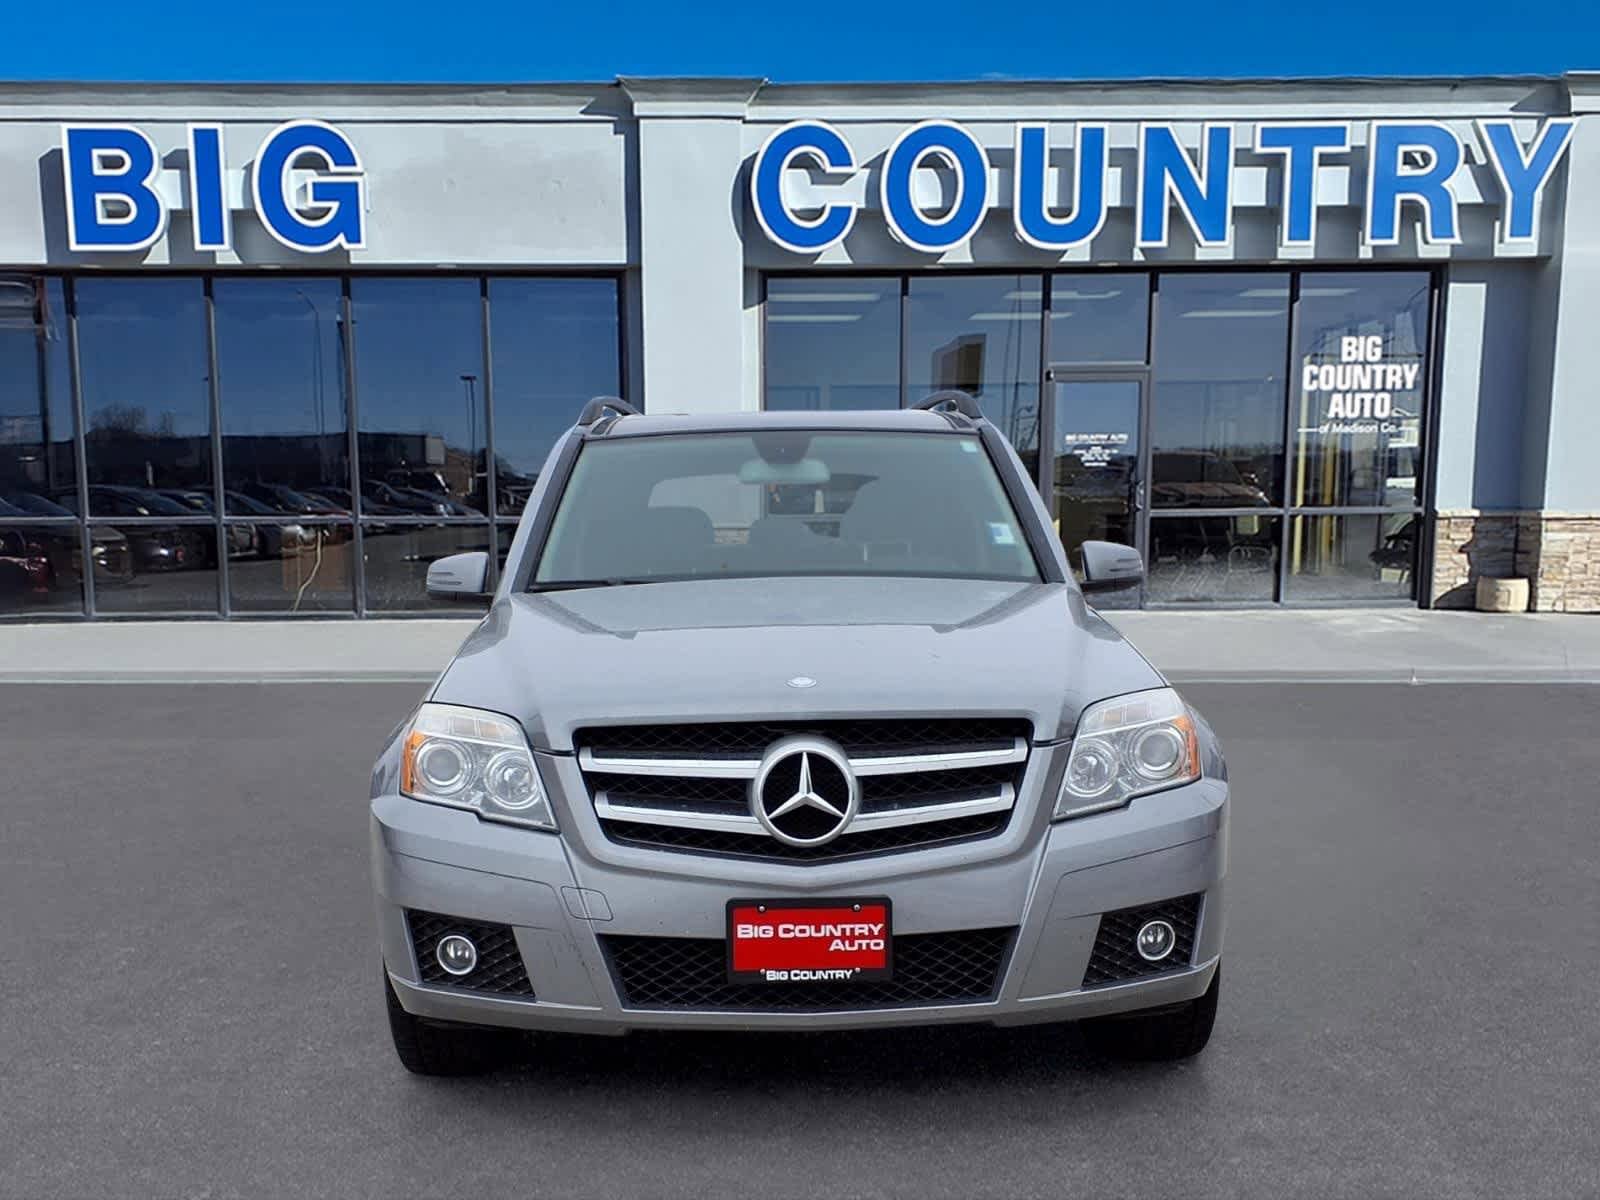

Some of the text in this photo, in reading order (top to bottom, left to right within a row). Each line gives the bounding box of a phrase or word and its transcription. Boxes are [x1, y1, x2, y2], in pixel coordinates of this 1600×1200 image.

[61, 119, 1574, 254] BIG COUNTRY
[1341, 336, 1382, 362] BIG
[1302, 363, 1419, 391] COUNTRY
[1327, 392, 1391, 419] AUTO
[736, 923, 884, 938] BIG COUNTRY
[829, 939, 885, 951] AUTO
[766, 969, 853, 980] BIG COUNTRY
